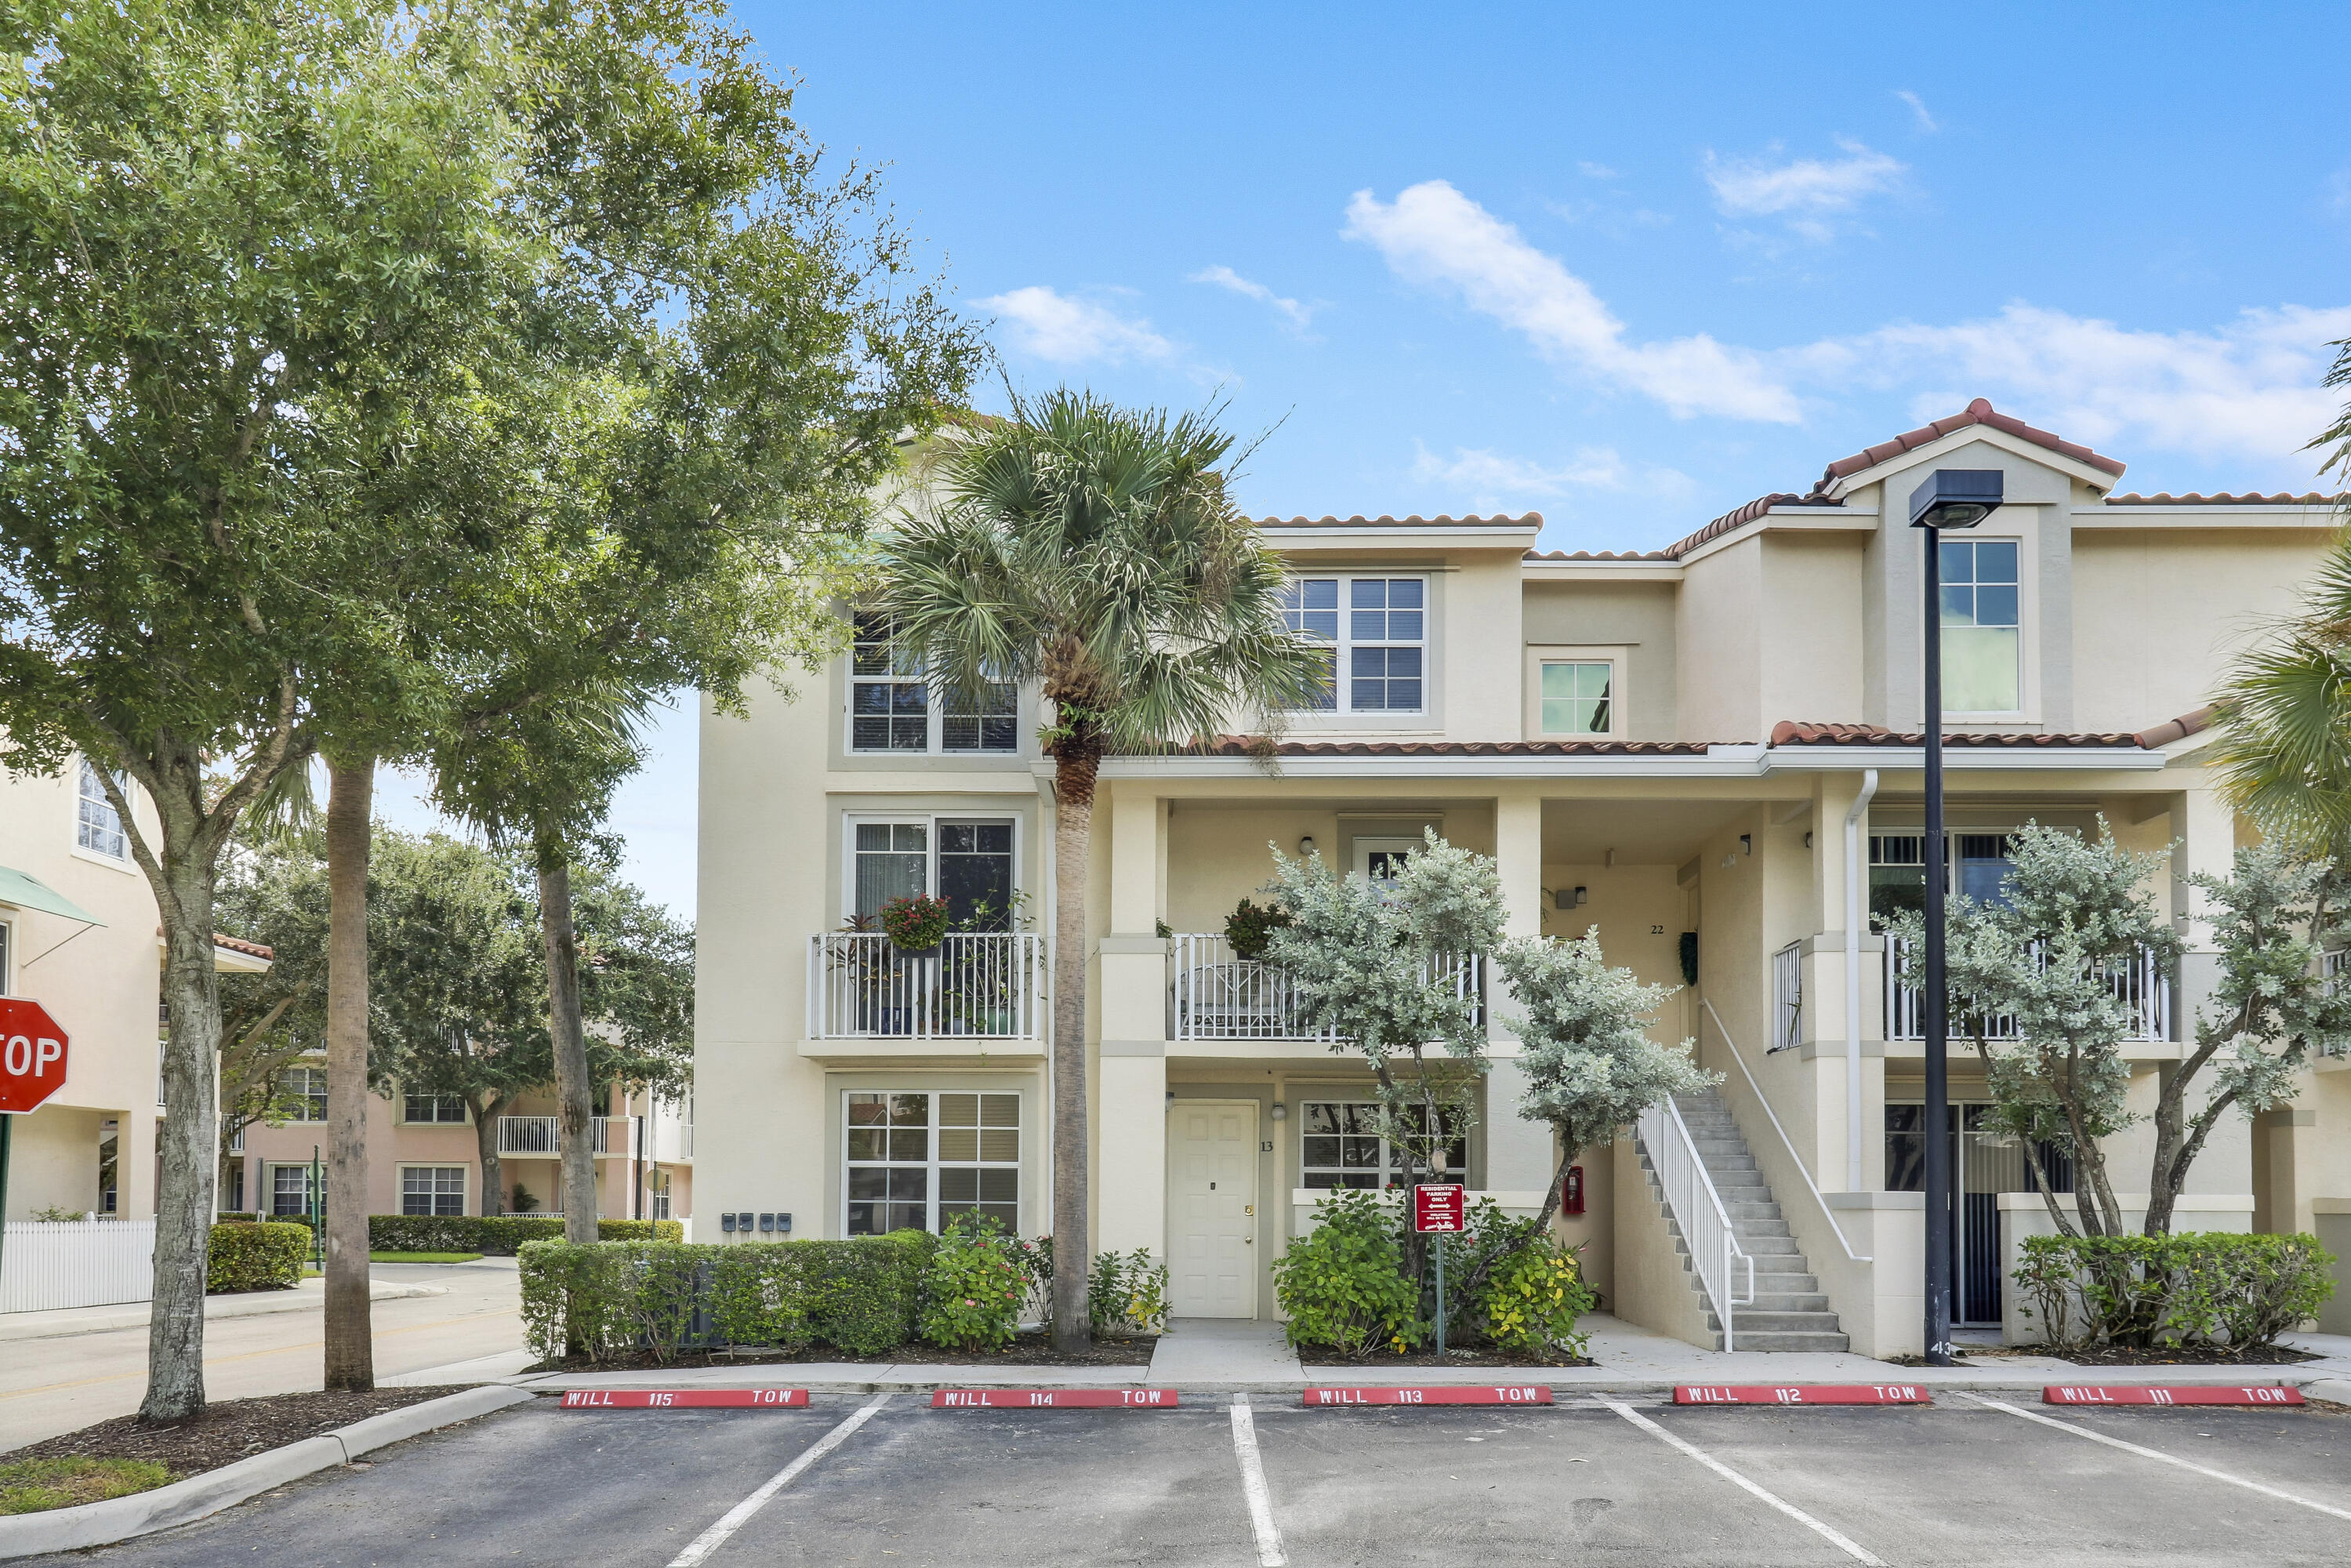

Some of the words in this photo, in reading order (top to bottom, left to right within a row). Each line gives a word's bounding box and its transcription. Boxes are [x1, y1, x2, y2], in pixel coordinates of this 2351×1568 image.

[1650, 925, 1664, 935] 22
[0, 1033, 63, 1078] OP
[1261, 1141, 1274, 1152] 13
[1931, 1341, 1950, 1356] 43
[568, 1392, 614, 1406] WILL
[648, 1392, 673, 1406] 115
[752, 1389, 793, 1403] TOW
[945, 1392, 992, 1406] WILL
[1029, 1392, 1054, 1406] 114
[1122, 1390, 1162, 1403] TOW
[1319, 1390, 1369, 1404] WILL
[1398, 1390, 1423, 1403] 113
[1495, 1388, 1537, 1402] TOW
[1688, 1387, 1739, 1402] WILL
[1774, 1388, 1802, 1403] 112
[1873, 1385, 1917, 1399] TOW
[2060, 1387, 2115, 1402] WILL
[2148, 1388, 2175, 1405] 111
[2240, 1387, 2288, 1402] TOW
